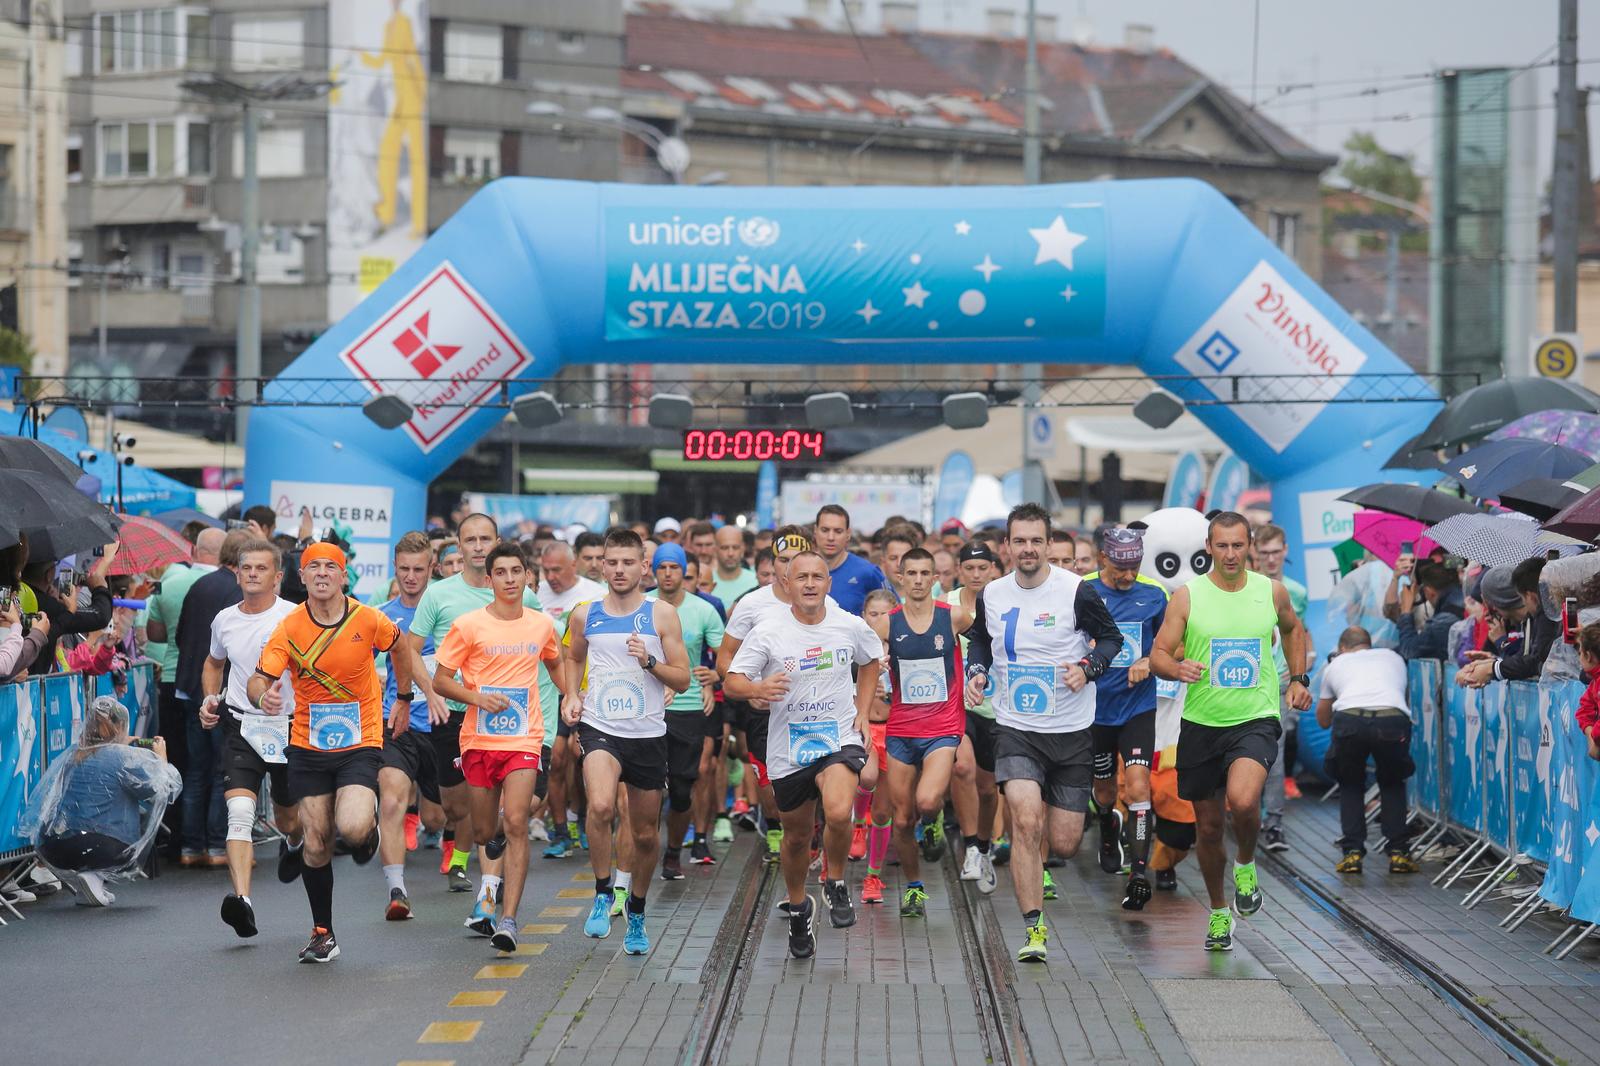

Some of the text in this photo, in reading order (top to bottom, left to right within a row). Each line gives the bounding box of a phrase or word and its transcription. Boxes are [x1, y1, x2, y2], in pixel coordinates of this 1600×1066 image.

[628, 216, 735, 246] unicef
[628, 256, 807, 294] MLIJEČNA
[627, 301, 827, 330] STAZA 2019
[1254, 282, 1340, 378] Vindija
[1547, 348, 1566, 372] S
[416, 342, 502, 421] Kaufland
[685, 430, 824, 460] 00:00:04
[1000, 607, 1021, 663] 1
[485, 643, 524, 656] unicef
[1222, 667, 1250, 681] 1419
[910, 684, 937, 697] 2027
[1021, 693, 1039, 707] 37
[607, 697, 633, 712] 1914
[488, 715, 517, 730] 496
[326, 732, 345, 747] 67
